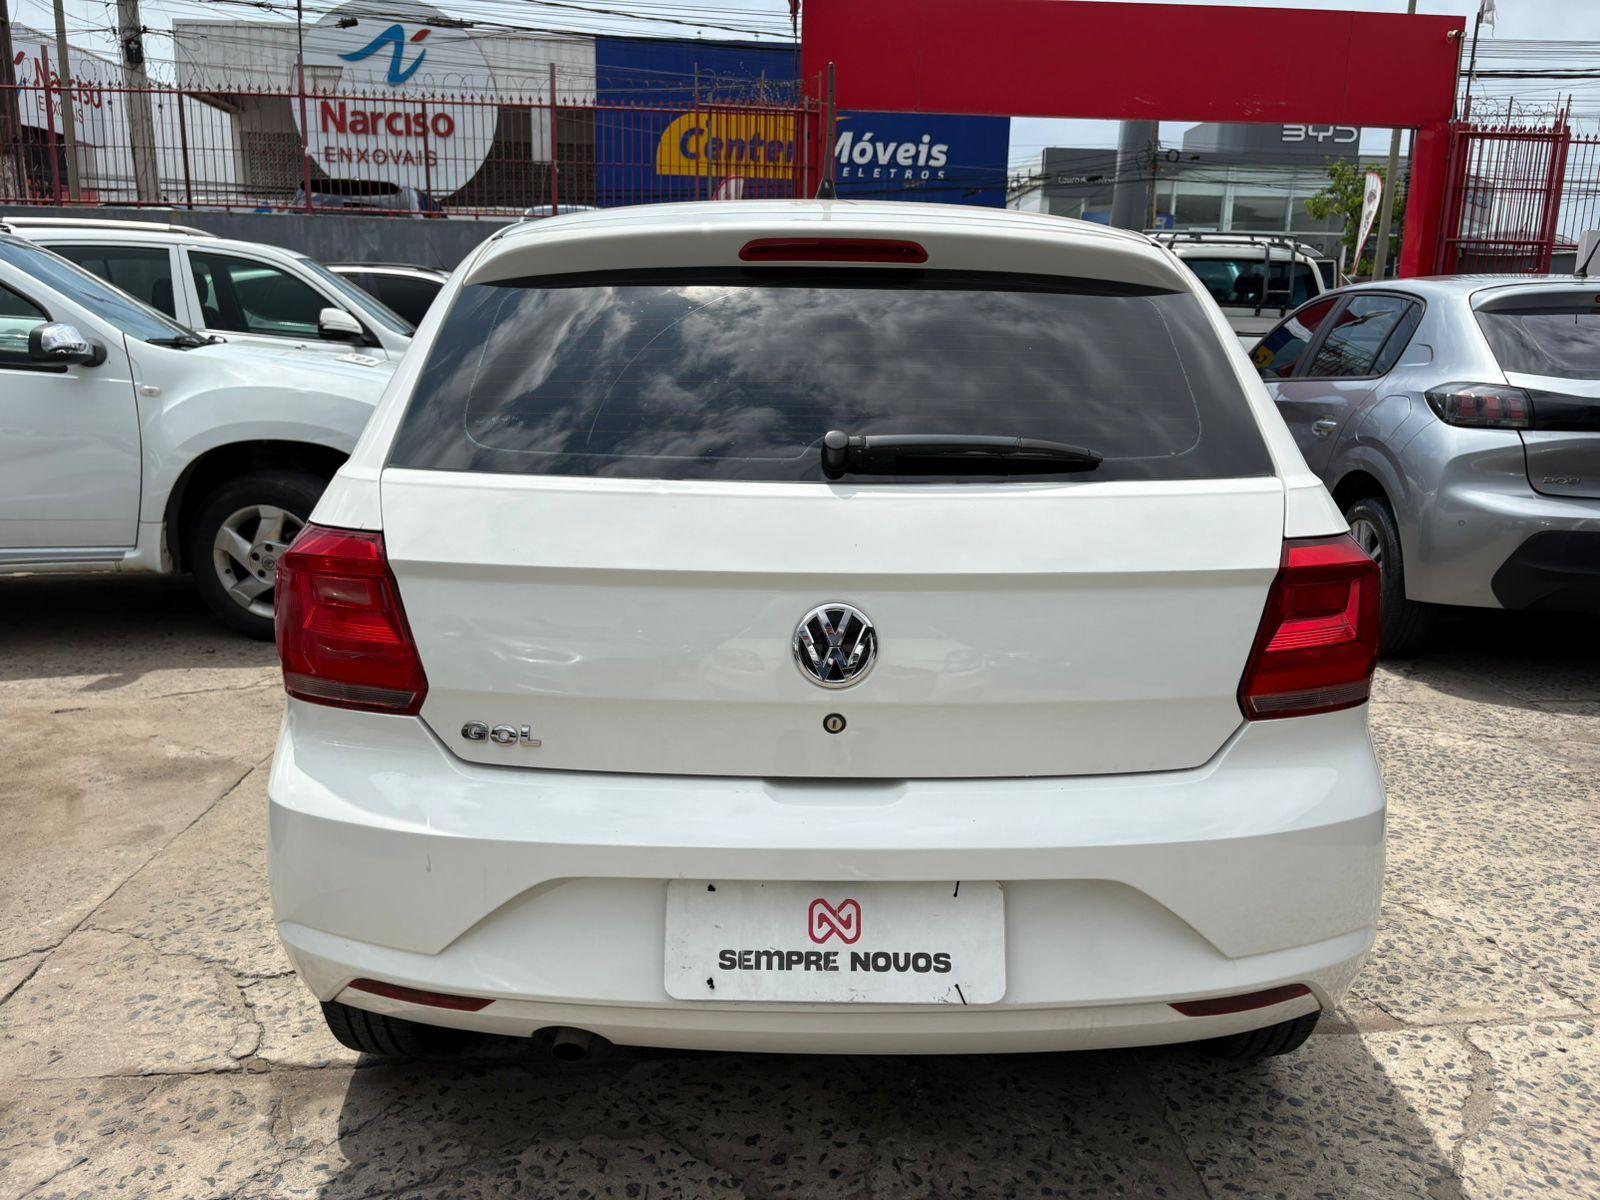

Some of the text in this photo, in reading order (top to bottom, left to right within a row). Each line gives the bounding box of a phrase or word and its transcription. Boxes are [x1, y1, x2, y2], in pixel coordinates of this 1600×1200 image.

[34, 57, 102, 109] Naciso
[320, 101, 455, 138] Narciso
[1282, 124, 1358, 143] BYD
[324, 146, 438, 167] ENXOVAIS
[834, 131, 949, 168] Móveis
[842, 167, 945, 179] ELETROS
[461, 719, 542, 747] GOL
[718, 949, 952, 973] SEMPRE NOVOS
